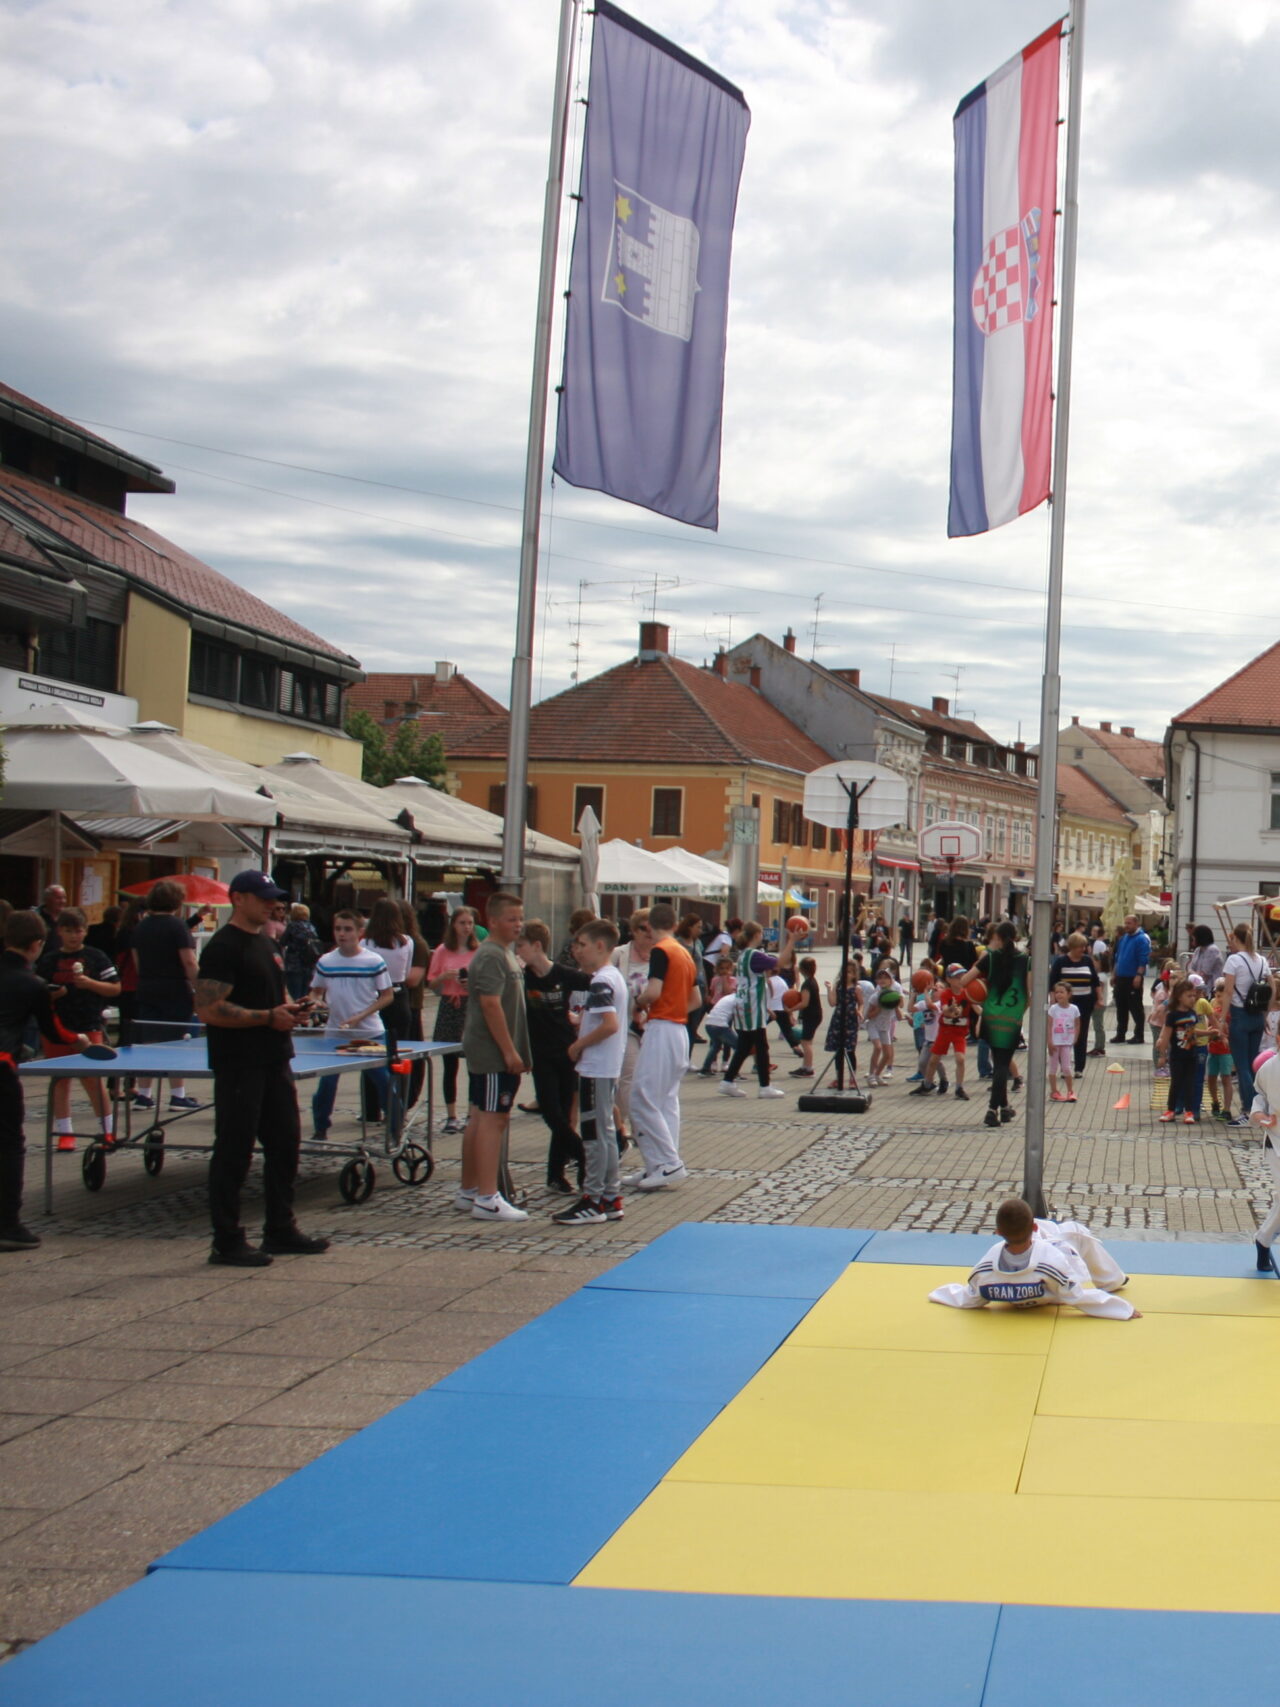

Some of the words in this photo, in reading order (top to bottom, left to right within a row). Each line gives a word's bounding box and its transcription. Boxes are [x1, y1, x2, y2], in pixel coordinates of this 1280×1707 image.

[604, 883, 628, 892] PAN
[655, 885, 679, 893] PAN
[988, 1285, 1014, 1299] FRAN
